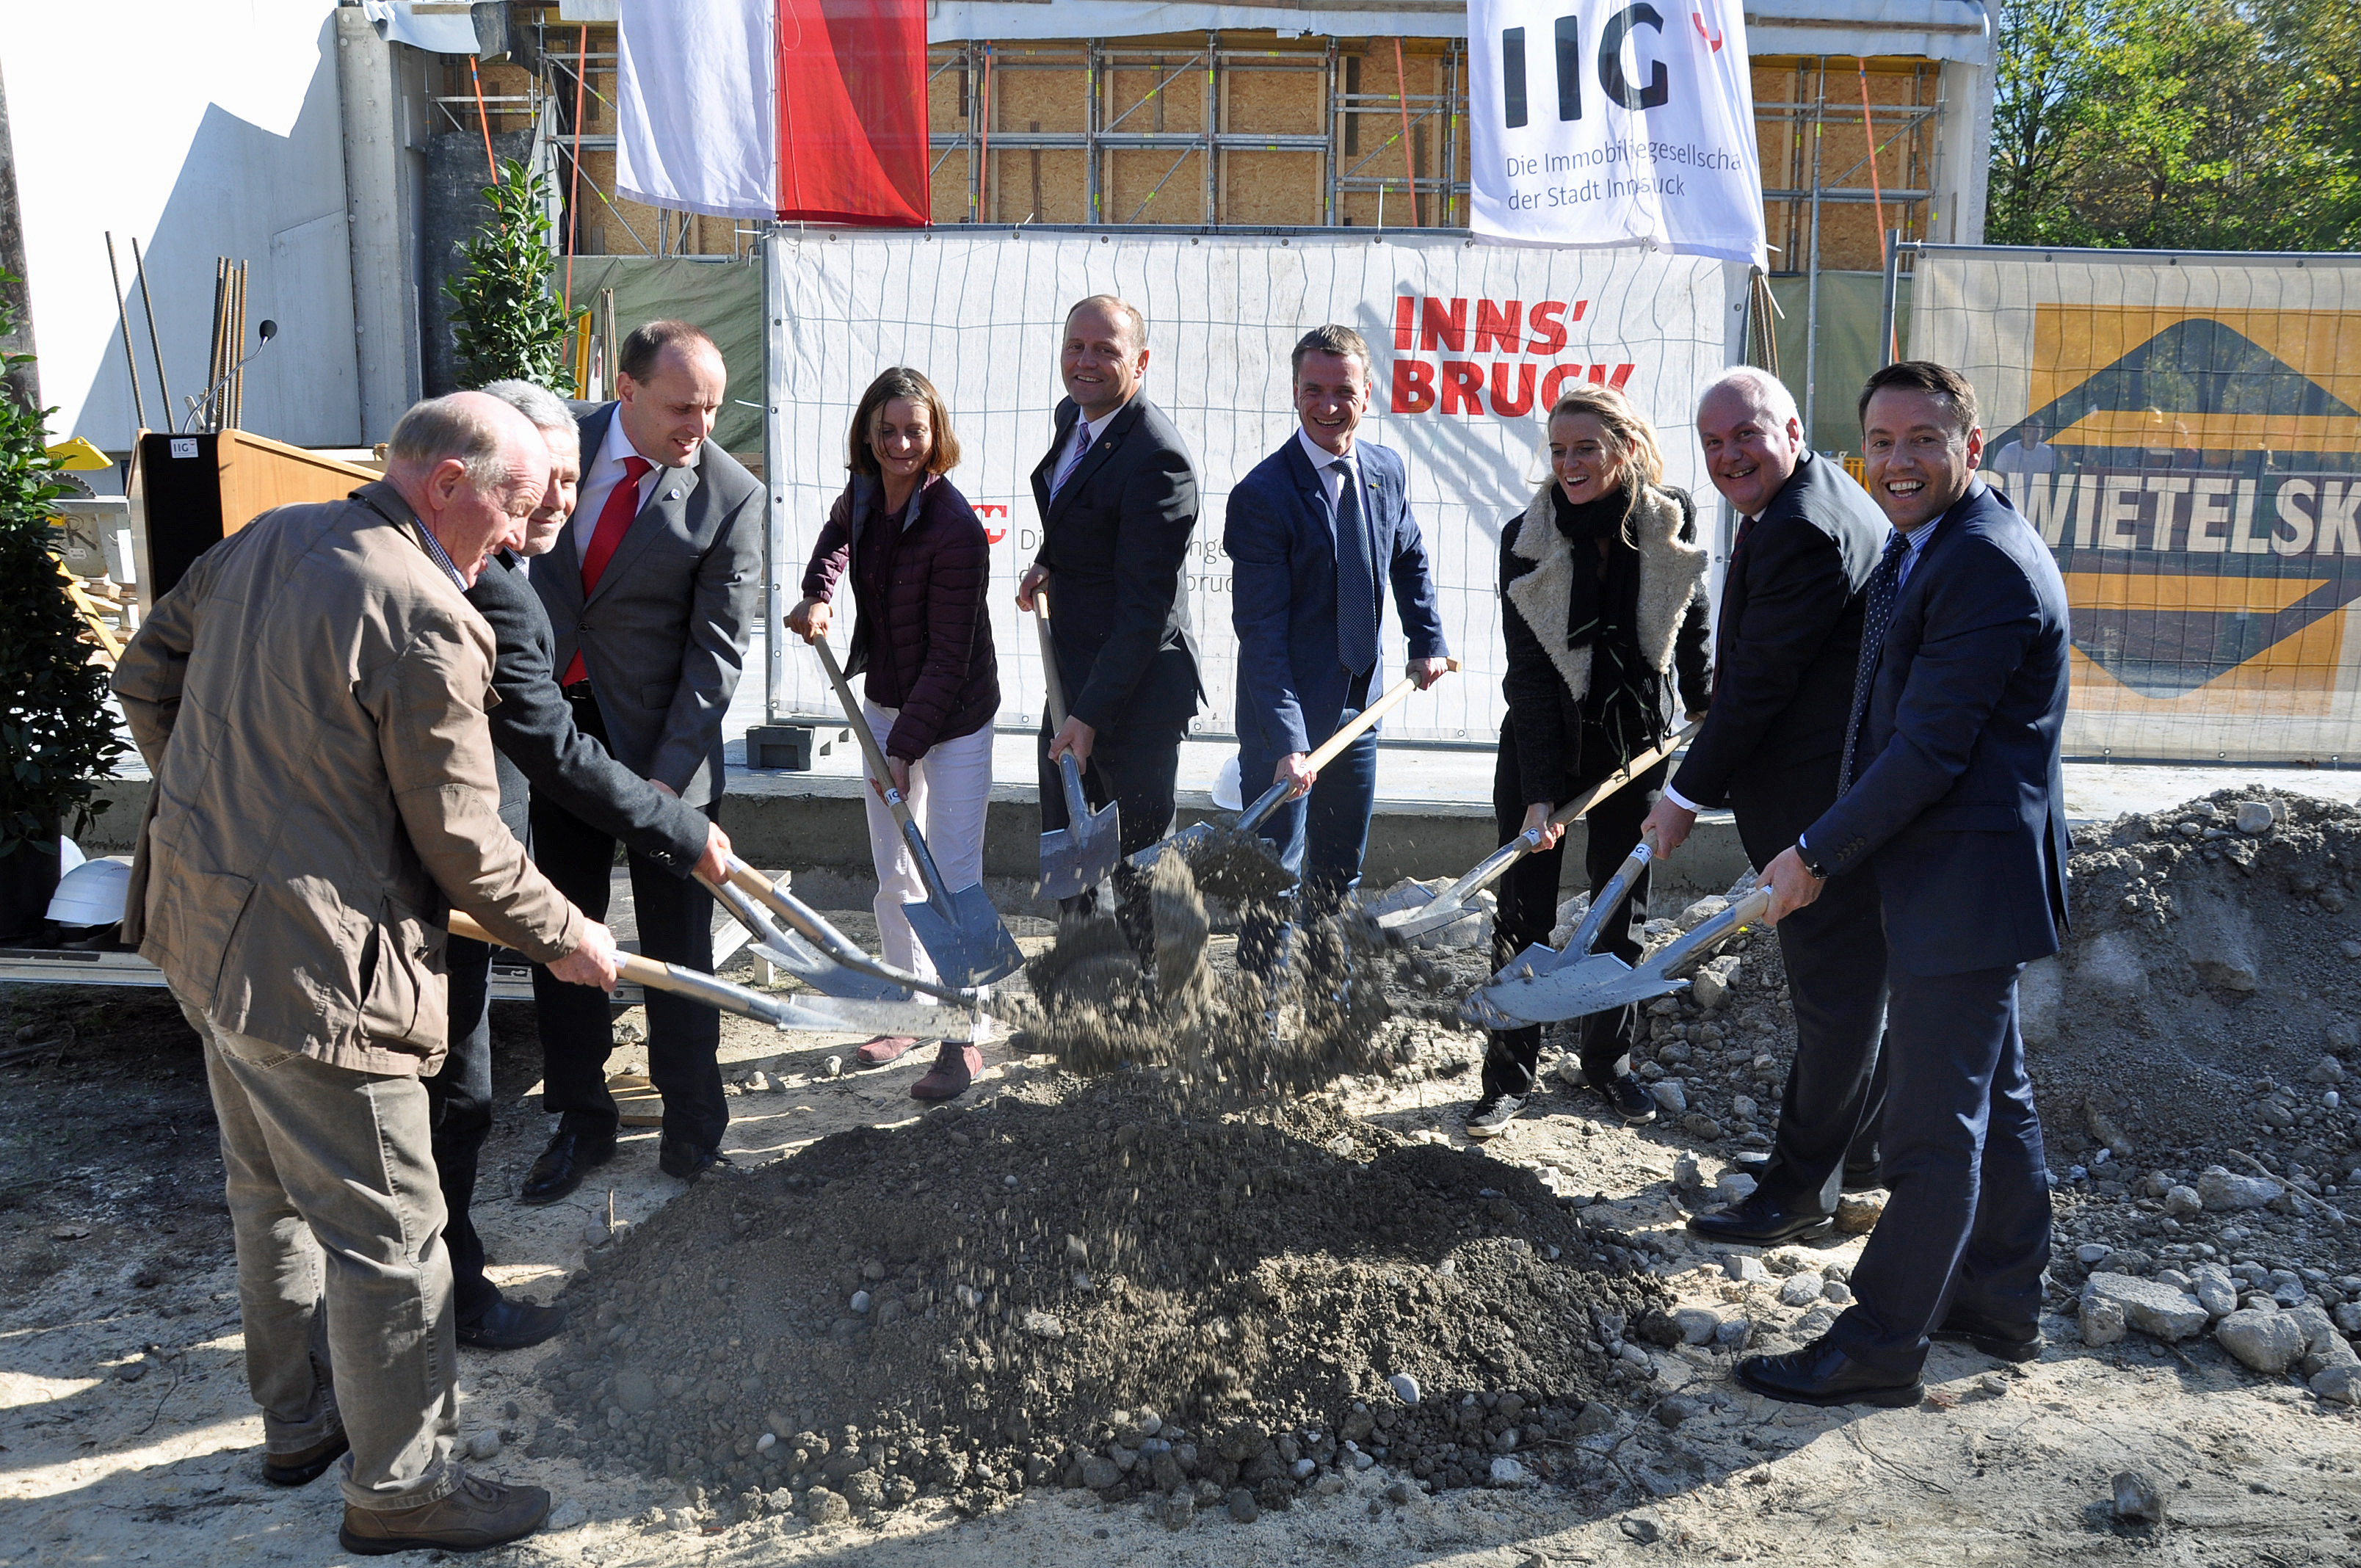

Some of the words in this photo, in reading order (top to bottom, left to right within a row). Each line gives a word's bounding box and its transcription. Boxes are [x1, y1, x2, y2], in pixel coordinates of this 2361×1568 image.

[1503, 2, 1668, 128] IIG
[1507, 155, 1537, 177] Die
[1509, 189, 1541, 211] der
[1548, 179, 1601, 207] Stadt
